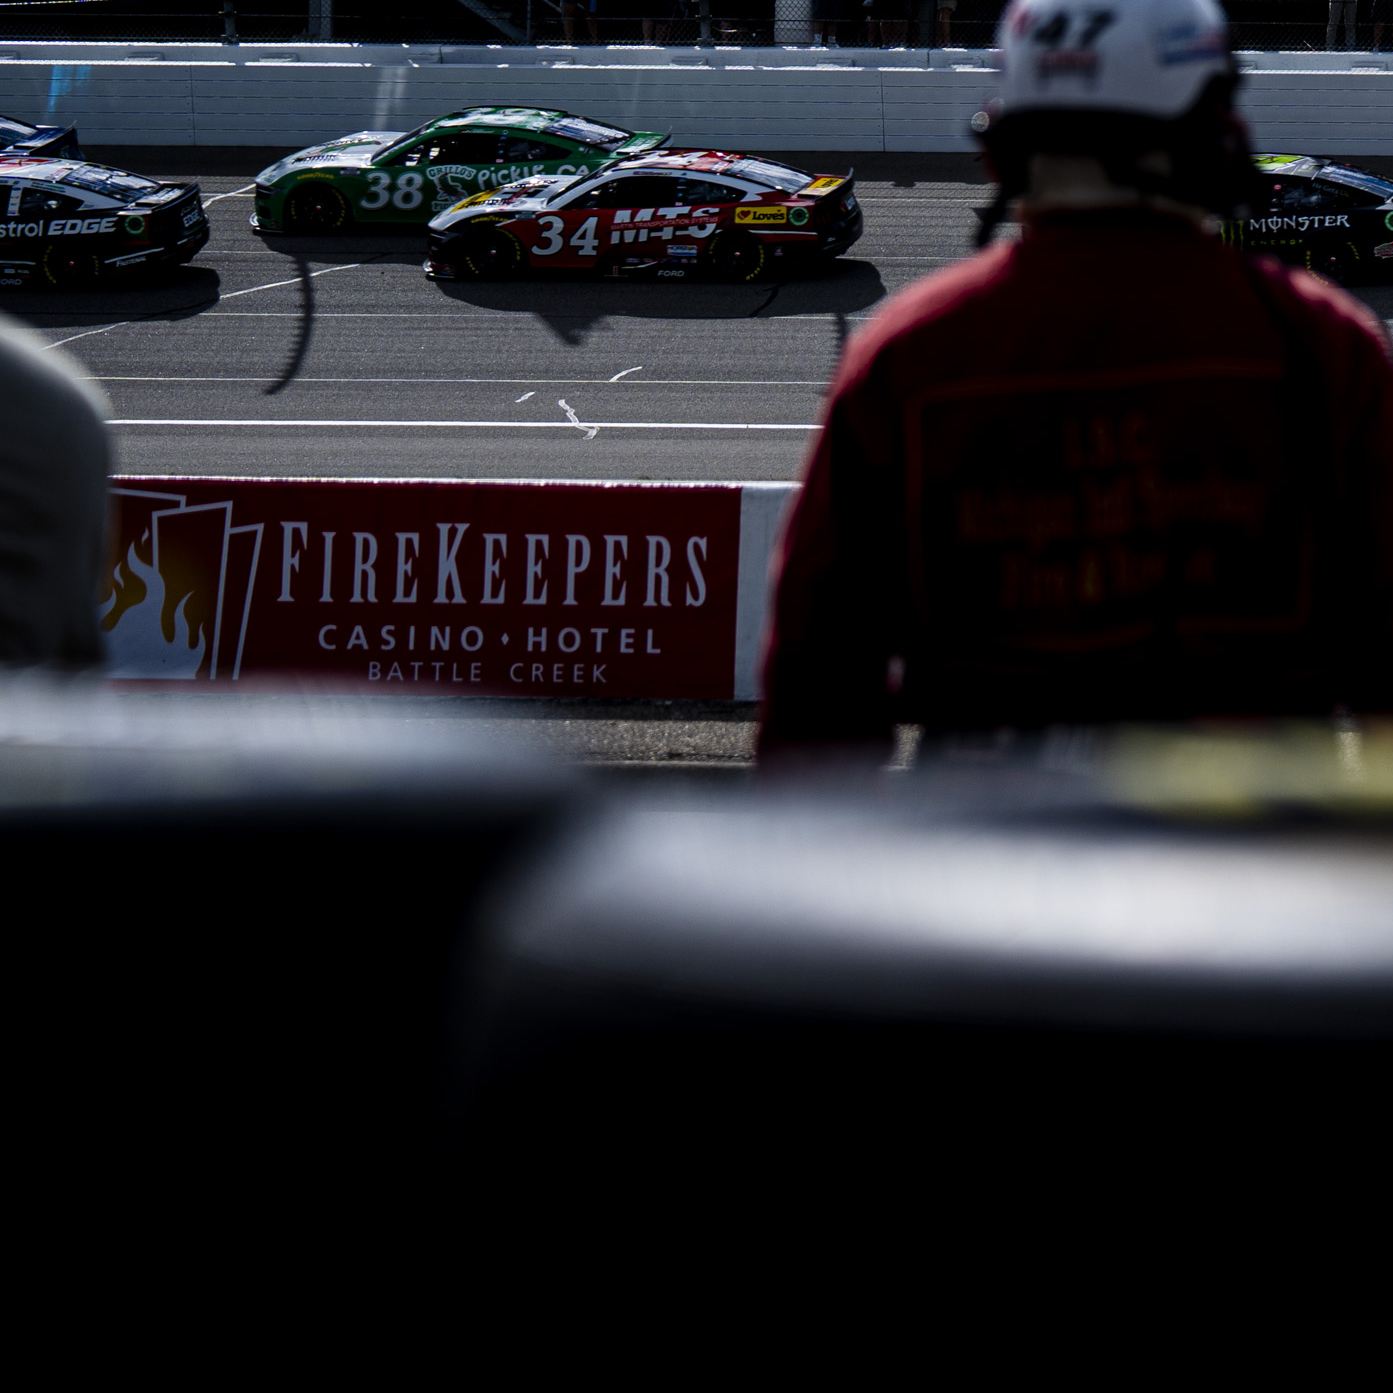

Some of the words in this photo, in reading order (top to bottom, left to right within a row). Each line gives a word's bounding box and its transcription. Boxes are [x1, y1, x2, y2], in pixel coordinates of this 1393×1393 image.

[359, 170, 425, 211] 38
[46, 216, 120, 236] EDGE
[530, 214, 600, 256] 34
[609, 206, 721, 244] MTS
[1249, 214, 1351, 234] MONSTER
[656, 269, 685, 277] FORD
[318, 622, 486, 654] CASINO
[526, 626, 663, 655] HOTEL
[366, 659, 484, 683] BATTLE
[508, 662, 609, 685] CREEK
